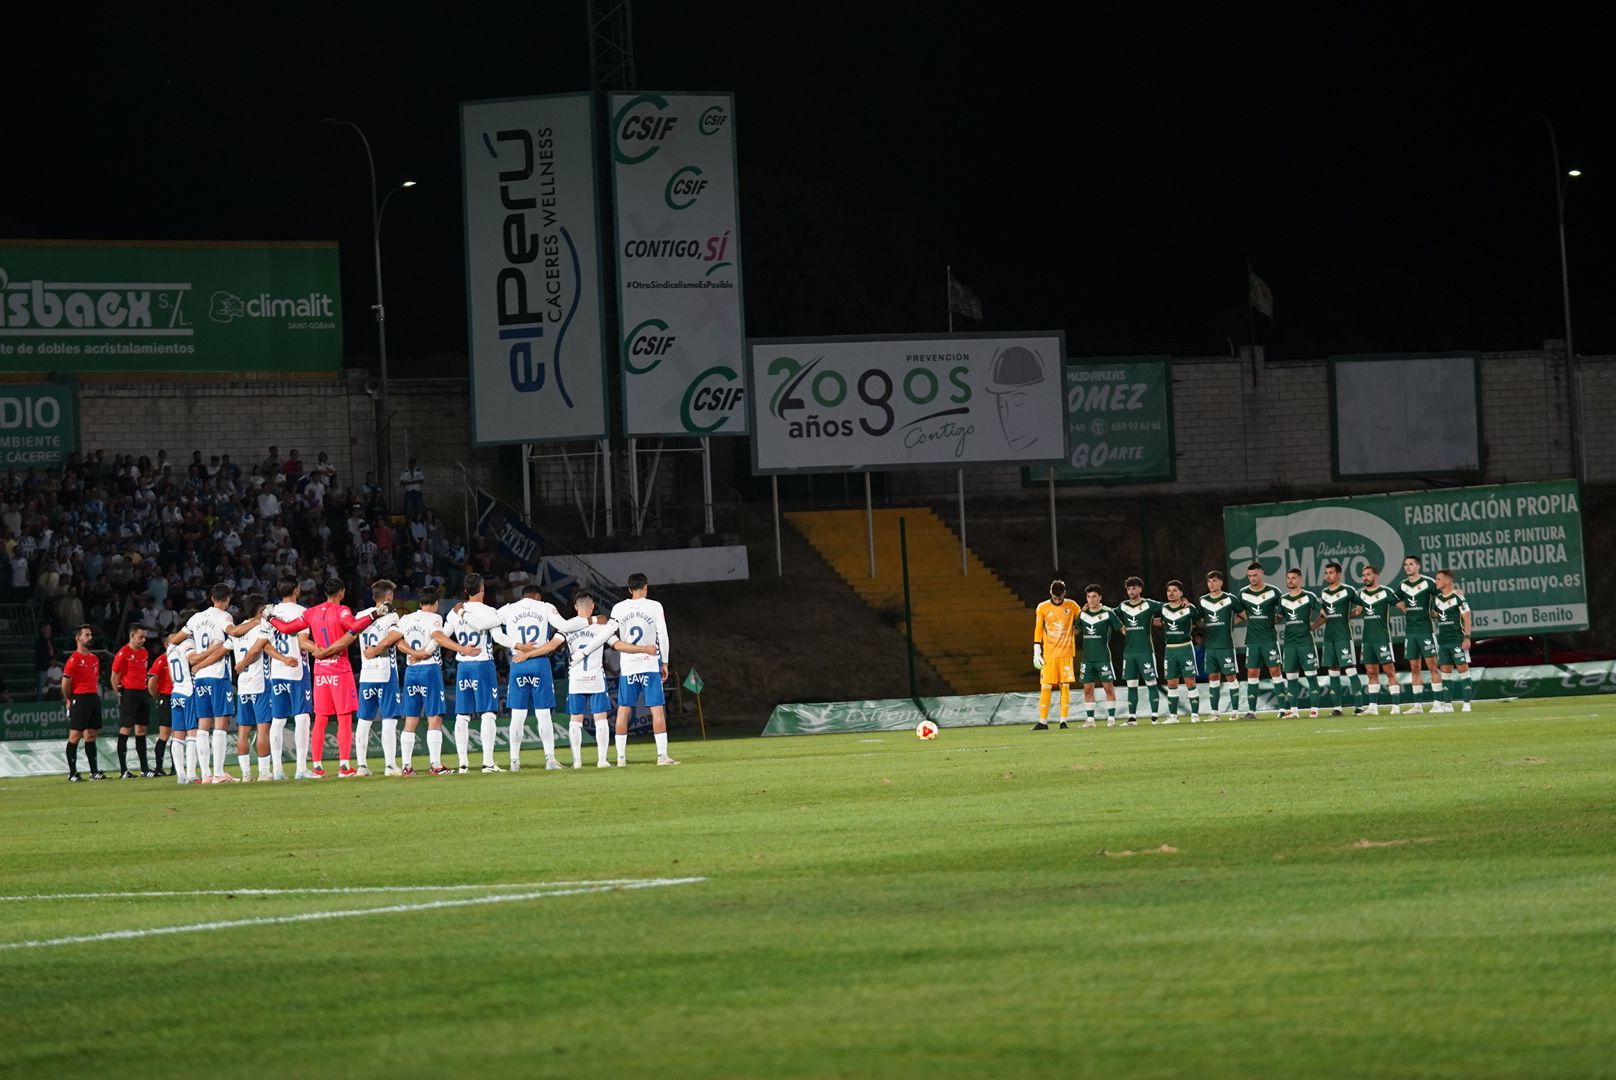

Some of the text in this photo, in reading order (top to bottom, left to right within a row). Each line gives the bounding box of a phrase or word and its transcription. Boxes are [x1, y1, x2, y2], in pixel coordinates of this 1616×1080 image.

[622, 116, 677, 140] CSIF
[538, 127, 557, 228] WELLNESS
[673, 180, 708, 196] CSIF
[624, 231, 731, 262] CONTIGO, SÍ
[626, 280, 733, 290] #OtroSindicalismoEsPosible
[246, 293, 334, 317] climalit
[17, 343, 33, 355] de
[38, 343, 81, 354] dobles
[84, 343, 195, 354] acristalamientos
[632, 336, 676, 356] CSIF
[905, 353, 970, 364] PREVENCIÓN
[694, 387, 744, 411] CSIF
[0, 396, 61, 429] DIO
[789, 415, 853, 439] años
[904, 423, 975, 458] Contigo
[1404, 493, 1579, 526] FABRICACIÓN PROPIA
[1419, 525, 1567, 551] TUS TIENDAS DE PINTURA
[1316, 541, 1366, 559] Pinturas
[1421, 543, 1568, 572] EN EXTREMADURA
[1503, 609, 1529, 625] Don
[1531, 605, 1574, 622] Benito
[518, 624, 540, 646] 12
[629, 625, 643, 645] 2
[315, 675, 340, 686] EAVE
[516, 675, 541, 688] EAVE
[626, 673, 649, 686] EAVE
